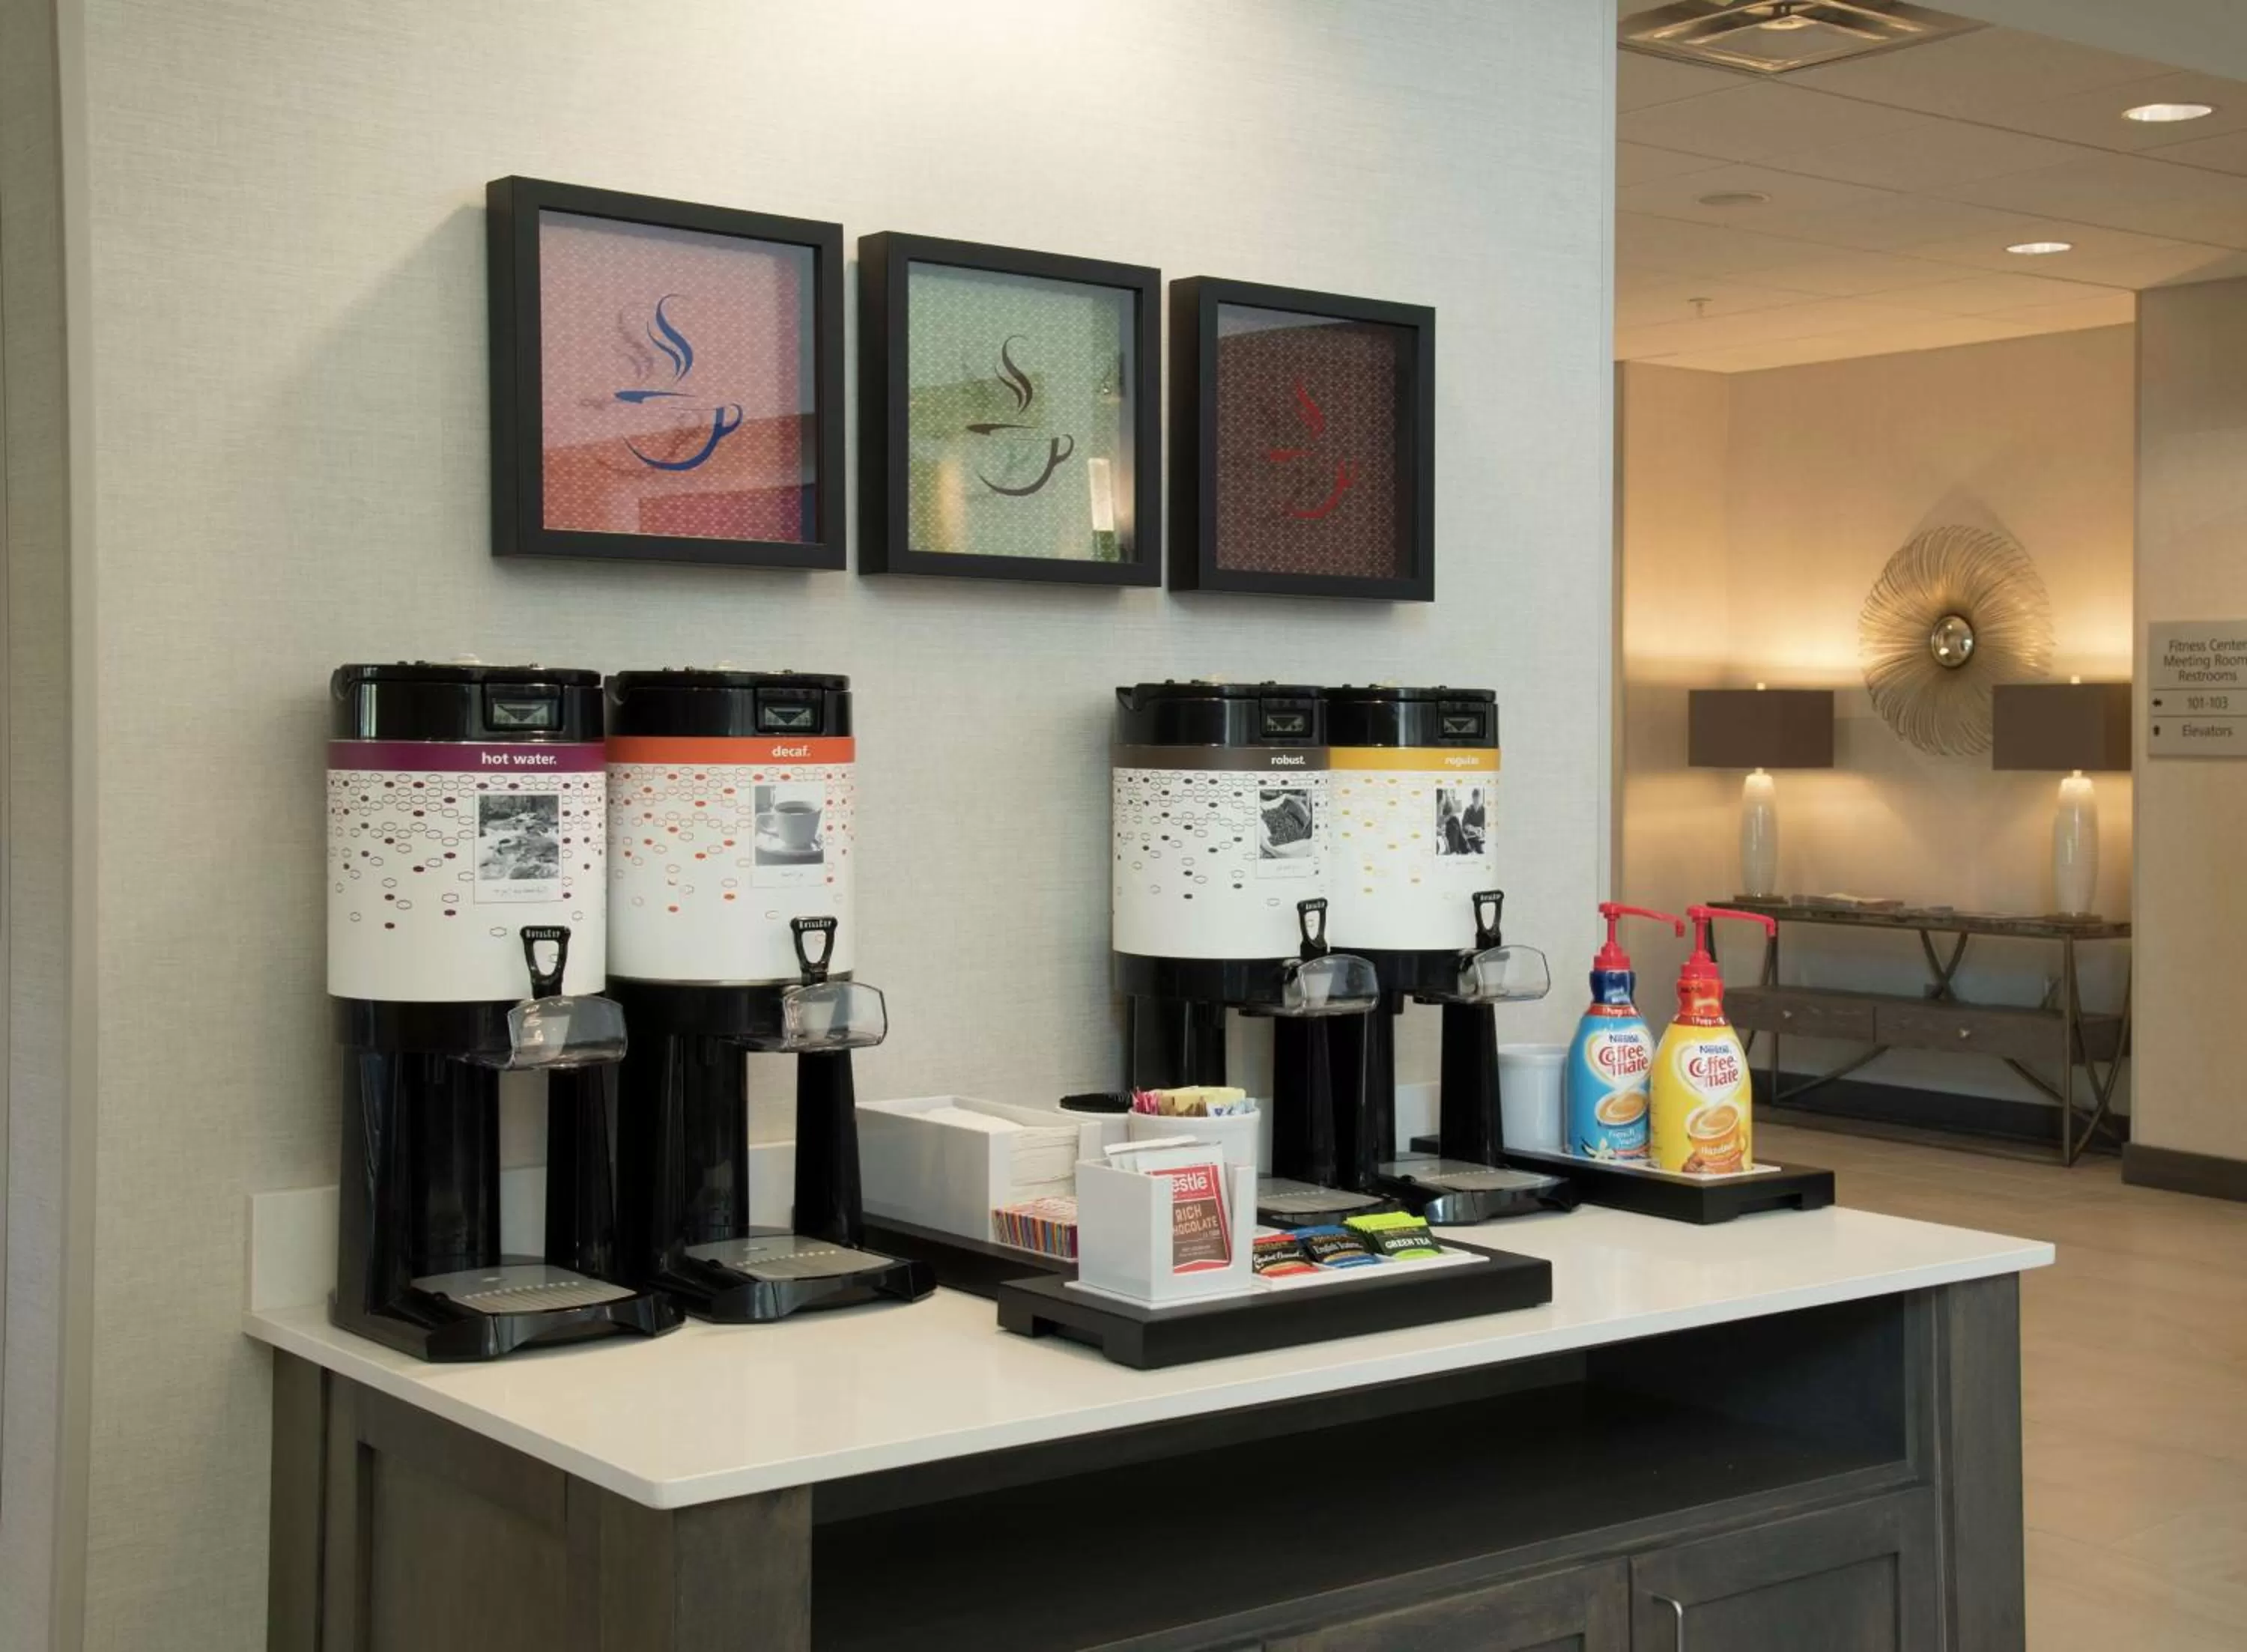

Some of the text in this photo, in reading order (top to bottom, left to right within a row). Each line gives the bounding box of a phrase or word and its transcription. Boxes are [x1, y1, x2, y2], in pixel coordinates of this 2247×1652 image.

[2169, 638, 2247, 652] Fitness Center
[2164, 654, 2247, 669] Meeting Room
[2178, 670, 2237, 682] Restrooms
[2187, 696, 2229, 710] 101-103
[482, 751, 557, 765] hot water.
[771, 745, 810, 758] decaf.
[1172, 1172, 1208, 1192] estlé
[1175, 1203, 1202, 1222] RICH
[1174, 1215, 1219, 1235] HOCOLATE
[1385, 1237, 1432, 1249] GREEN TEA
